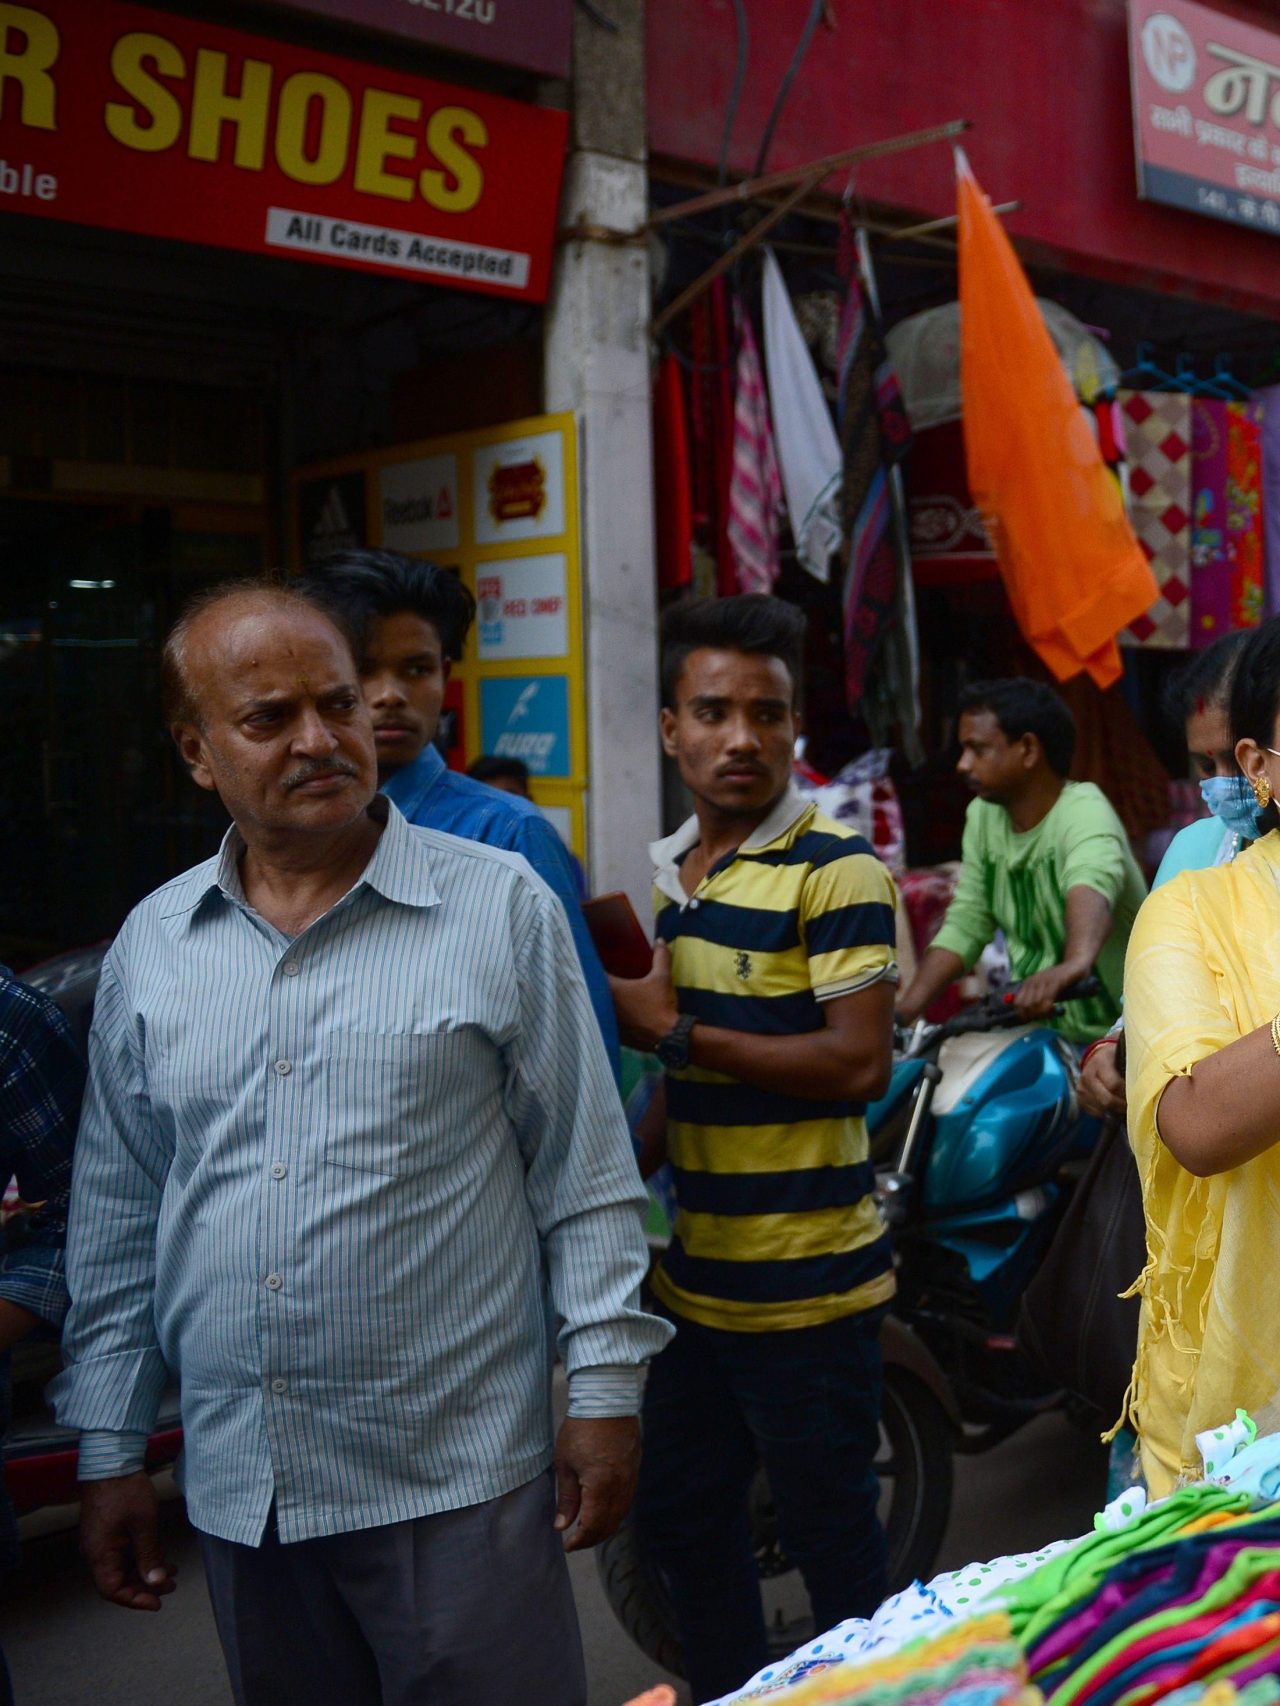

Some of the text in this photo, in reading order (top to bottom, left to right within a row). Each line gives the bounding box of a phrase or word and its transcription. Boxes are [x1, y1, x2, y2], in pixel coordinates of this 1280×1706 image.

[0, 2, 490, 213] R SHOES
[286, 215, 514, 275] All Cards Accepted
